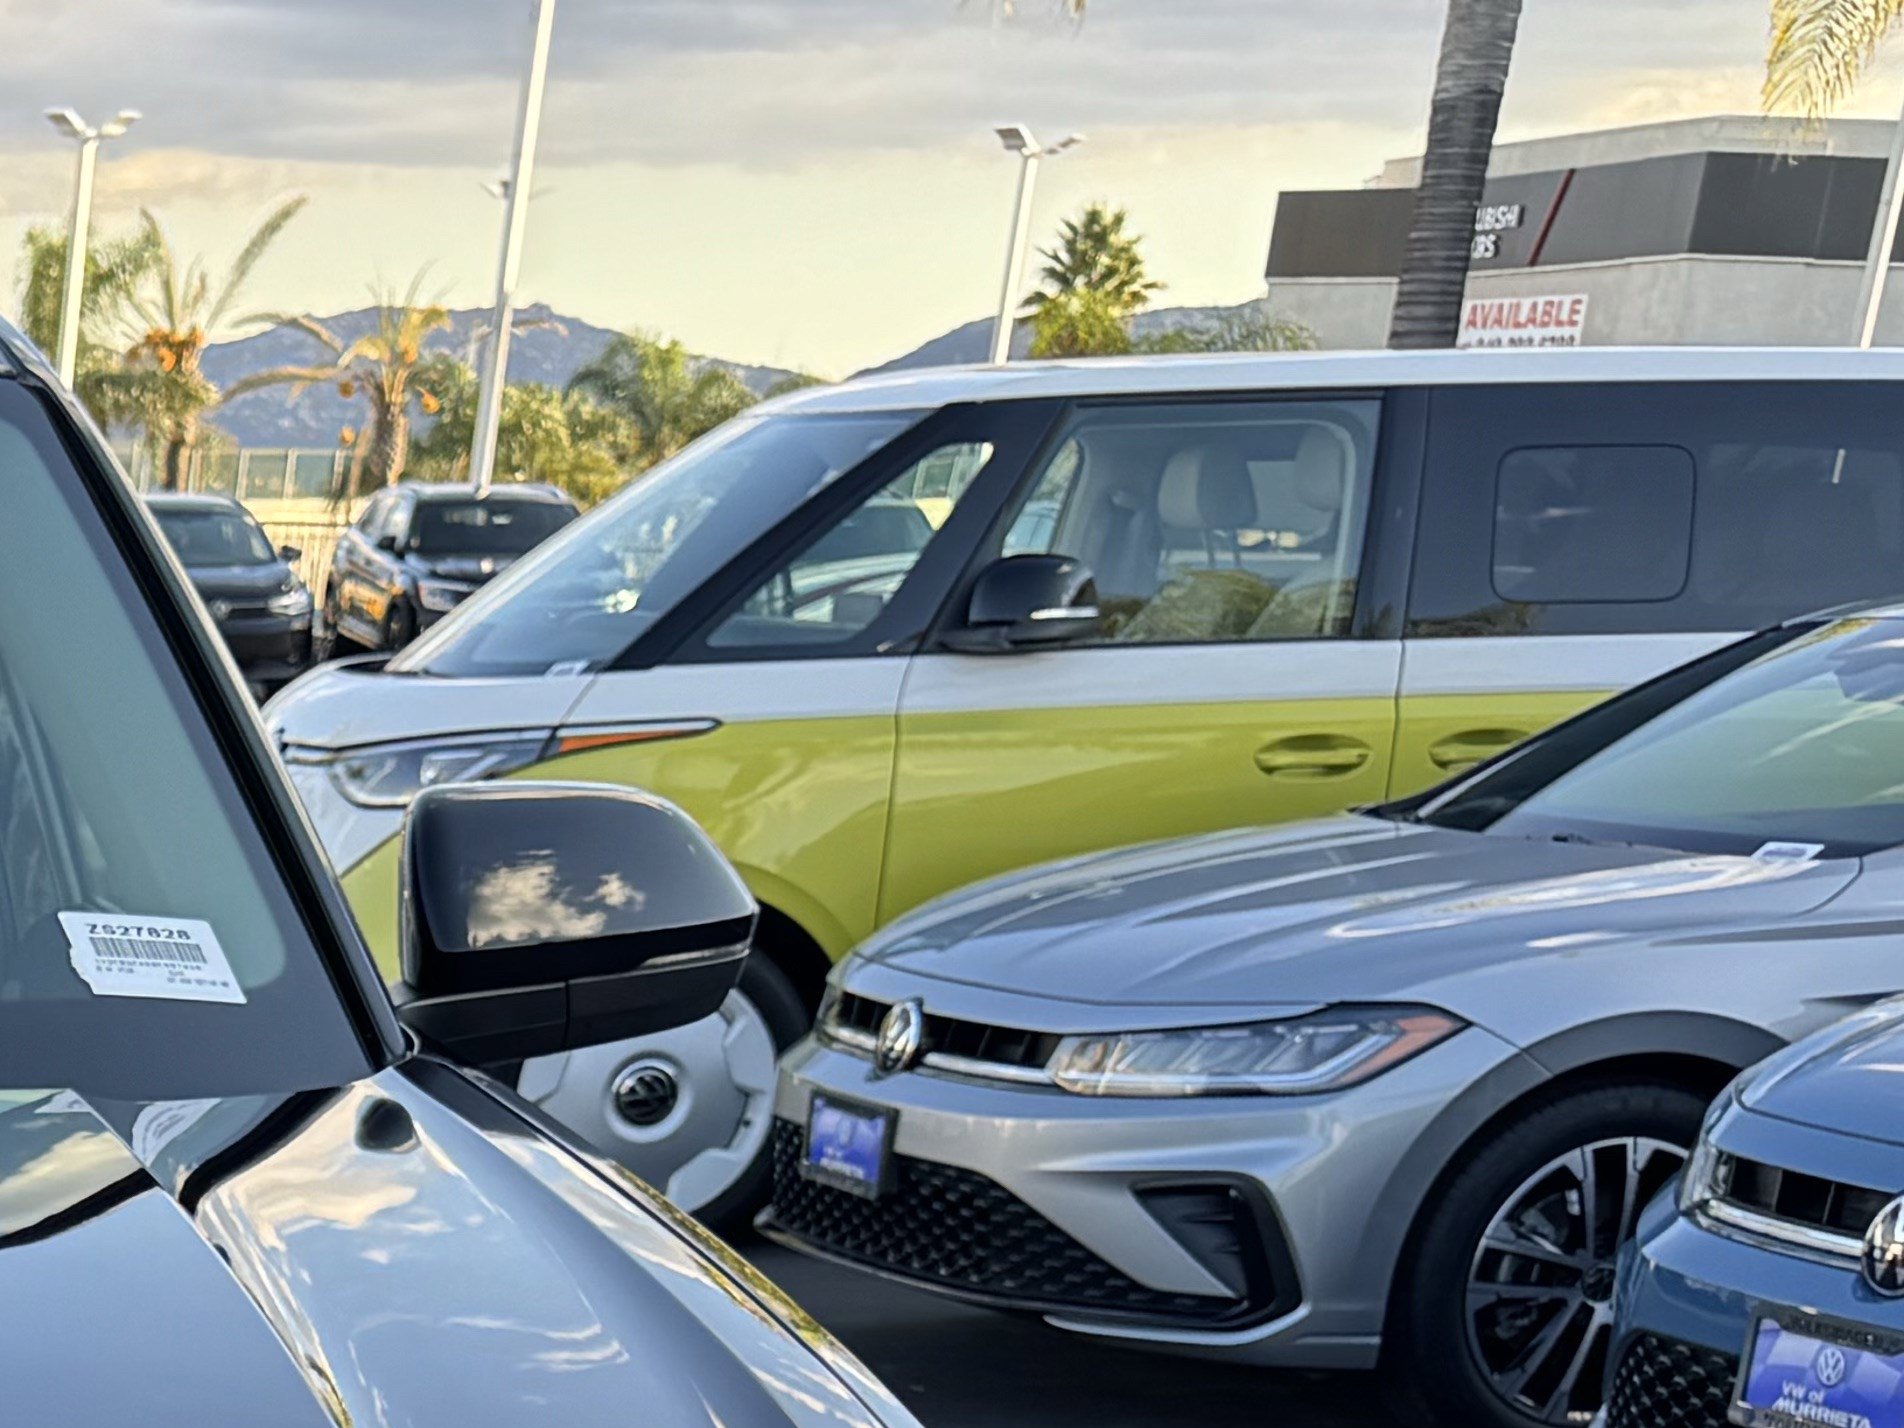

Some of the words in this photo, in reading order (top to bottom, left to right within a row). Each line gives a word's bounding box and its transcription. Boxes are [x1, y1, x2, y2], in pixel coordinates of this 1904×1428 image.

[1465, 299, 1583, 330] AVAILABLE
[1782, 1380, 1806, 1398] VW
[1808, 1389, 1825, 1403] of
